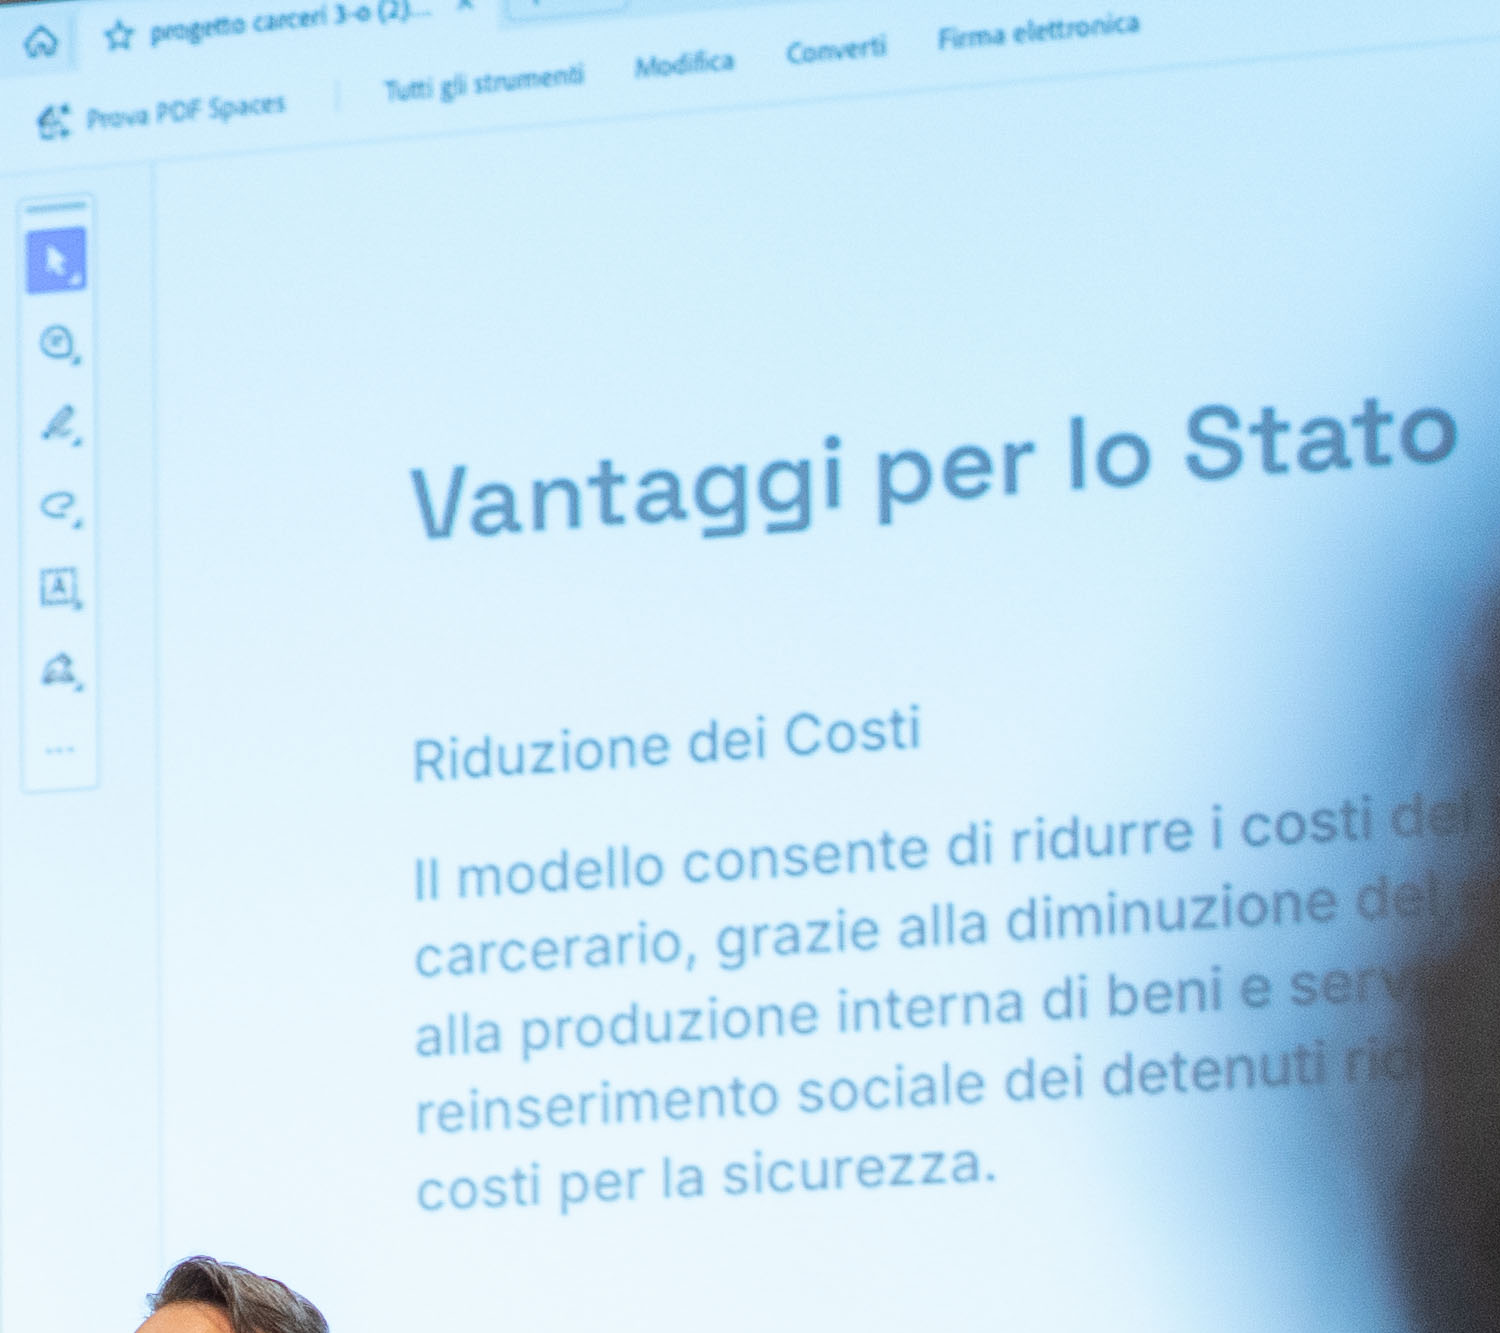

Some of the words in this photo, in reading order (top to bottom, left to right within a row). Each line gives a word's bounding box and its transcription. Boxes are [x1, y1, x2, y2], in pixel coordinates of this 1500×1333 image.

[150, 17, 247, 48] progetto
[252, 6, 327, 32] carceri
[786, 34, 888, 65] Converti
[938, 27, 1007, 50] Firma
[1012, 15, 1141, 44] elettronica
[384, 79, 433, 102] Tutti
[440, 75, 468, 104] gli
[473, 63, 585, 95] strumenti
[635, 49, 736, 78] Modifica
[86, 108, 150, 130] Prova
[156, 98, 202, 123] PDF
[208, 96, 286, 123] Spaces
[410, 434, 842, 540] Vantaggi
[878, 441, 1036, 526] per
[1070, 415, 1151, 491] lo
[1185, 398, 1457, 482] Stato
[415, 728, 671, 782] Riduzione
[688, 714, 765, 764] dei
[785, 703, 920, 757] Costi
[416, 857, 439, 901] Il
[459, 845, 665, 898] modello
[683, 831, 929, 884] consente
[947, 819, 992, 867] di
[1012, 815, 1194, 863] ridurre
[1210, 802, 1226, 851] i
[1241, 796, 1369, 849] costi
[415, 920, 696, 979] carcerario,
[716, 907, 880, 972] grazie
[899, 902, 988, 949] alla
[1006, 881, 1339, 943] diminuzione
[416, 1012, 502, 1058] alla
[522, 995, 819, 1063] produzione
[838, 988, 1024, 1033] interna
[1043, 973, 1088, 1021] di
[1108, 965, 1221, 1017] beni
[1241, 973, 1273, 1009] e
[417, 1077, 780, 1134] reinserimento
[798, 1062, 986, 1114] sociale
[1005, 1053, 1083, 1103] dei
[1103, 1039, 1326, 1098] detenuti
[417, 1161, 540, 1212] costi
[560, 1167, 645, 1216] per
[663, 1156, 705, 1199] la
[724, 1149, 996, 1196] sicurezza.
